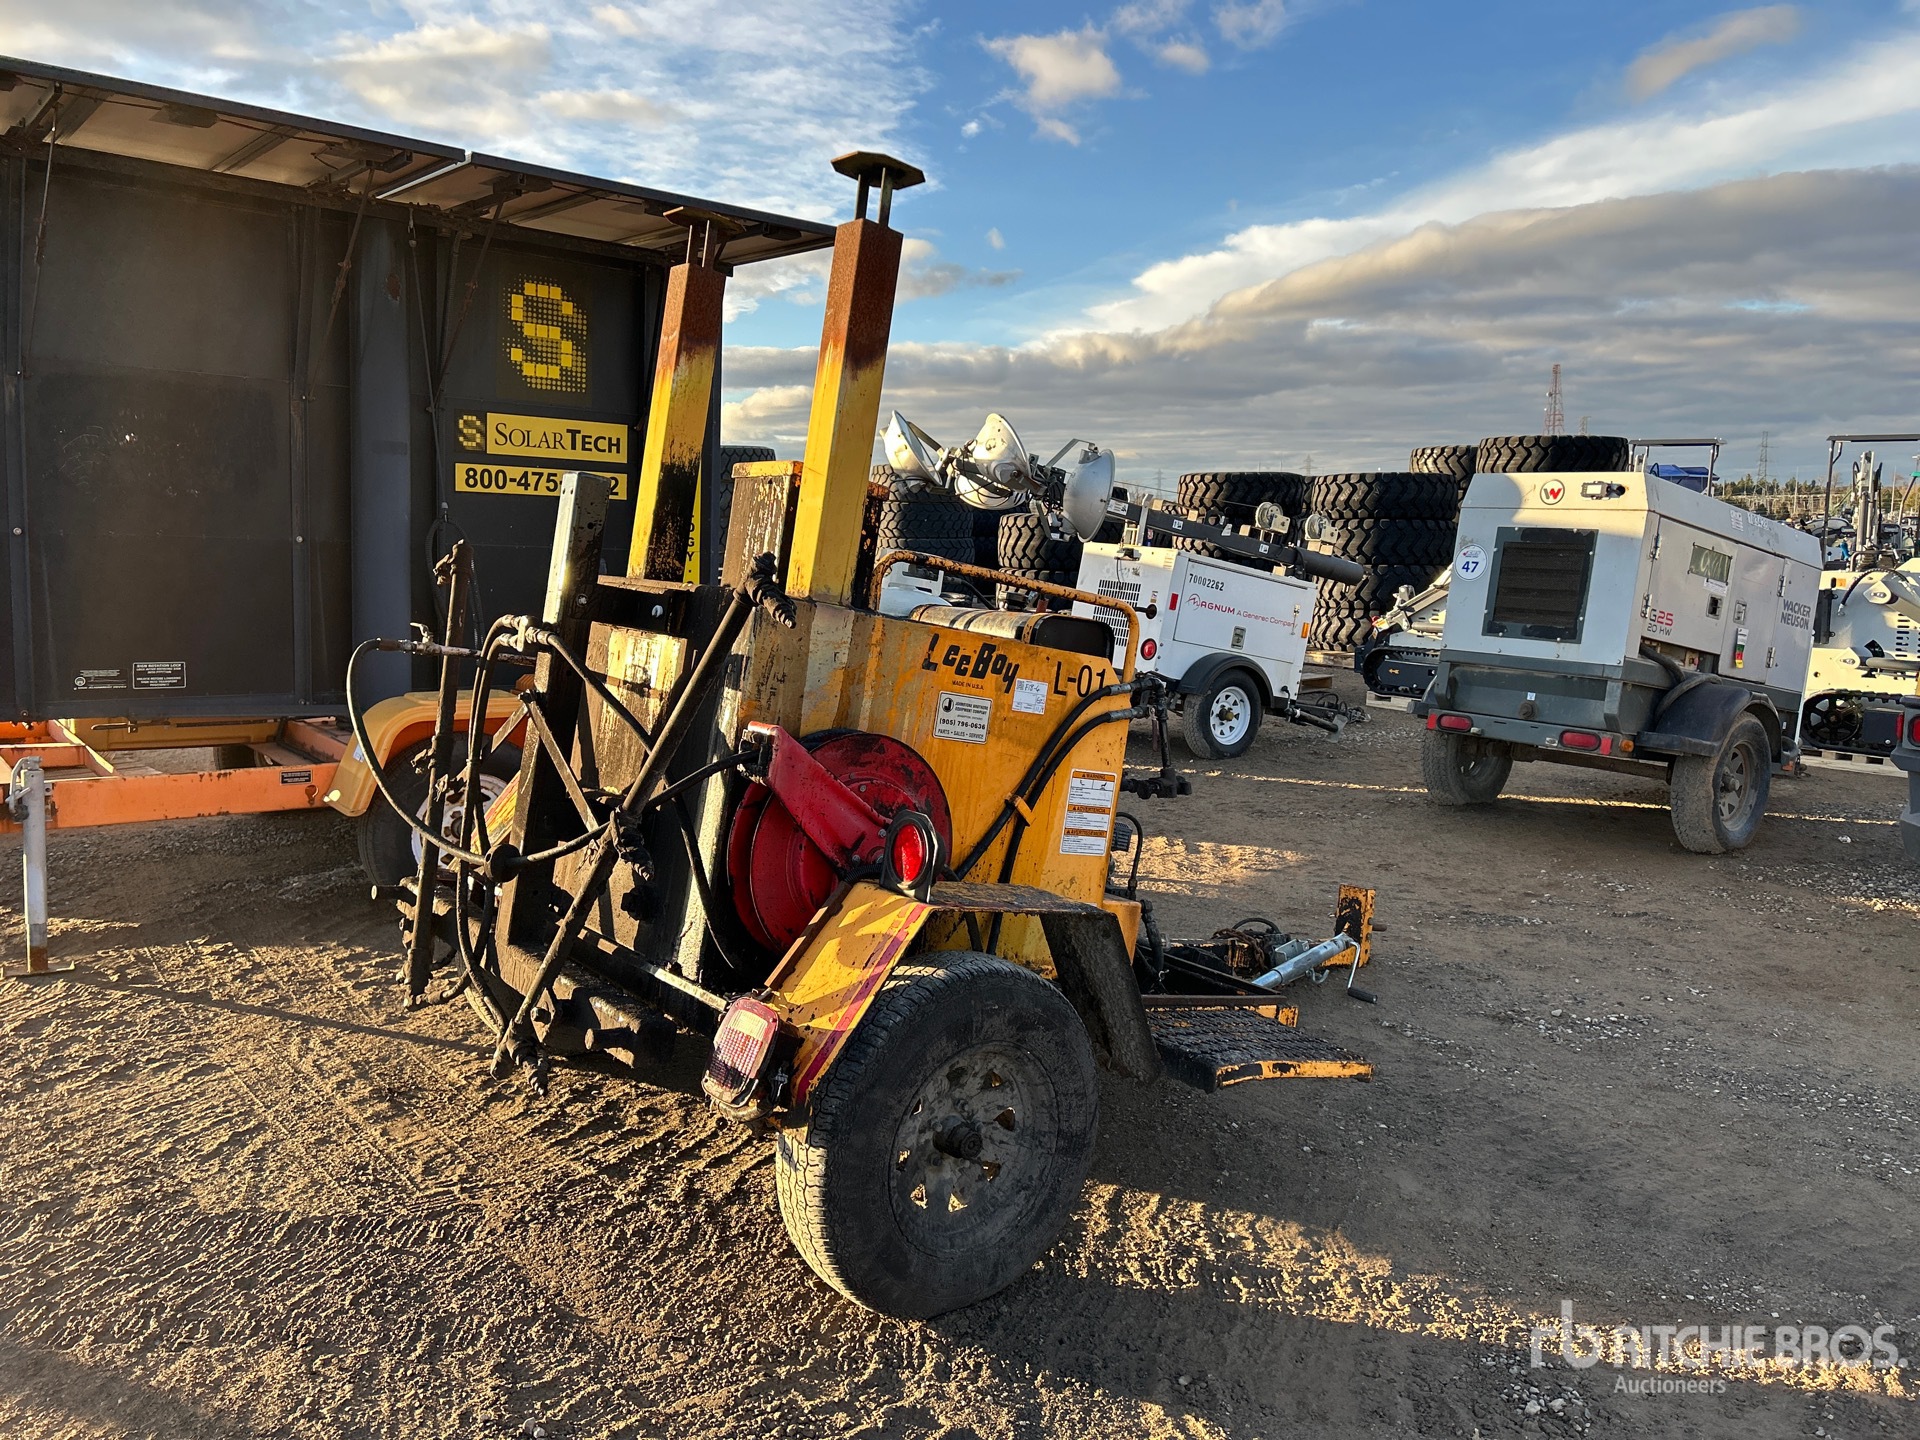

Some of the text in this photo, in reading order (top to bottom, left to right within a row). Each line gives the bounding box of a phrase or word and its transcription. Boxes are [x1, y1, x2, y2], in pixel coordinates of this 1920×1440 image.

[1461, 560, 1480, 573] 47
[1189, 574, 1225, 591] 70002262
[1783, 599, 1811, 617] WACKER
[1648, 608, 1674, 627] G25
[1781, 612, 1809, 629] NEUSON
[1646, 622, 1673, 637] 20 HW
[922, 633, 1020, 694] LeeBoy
[1053, 661, 1108, 698] L-01
[939, 718, 956, 726] (905)
